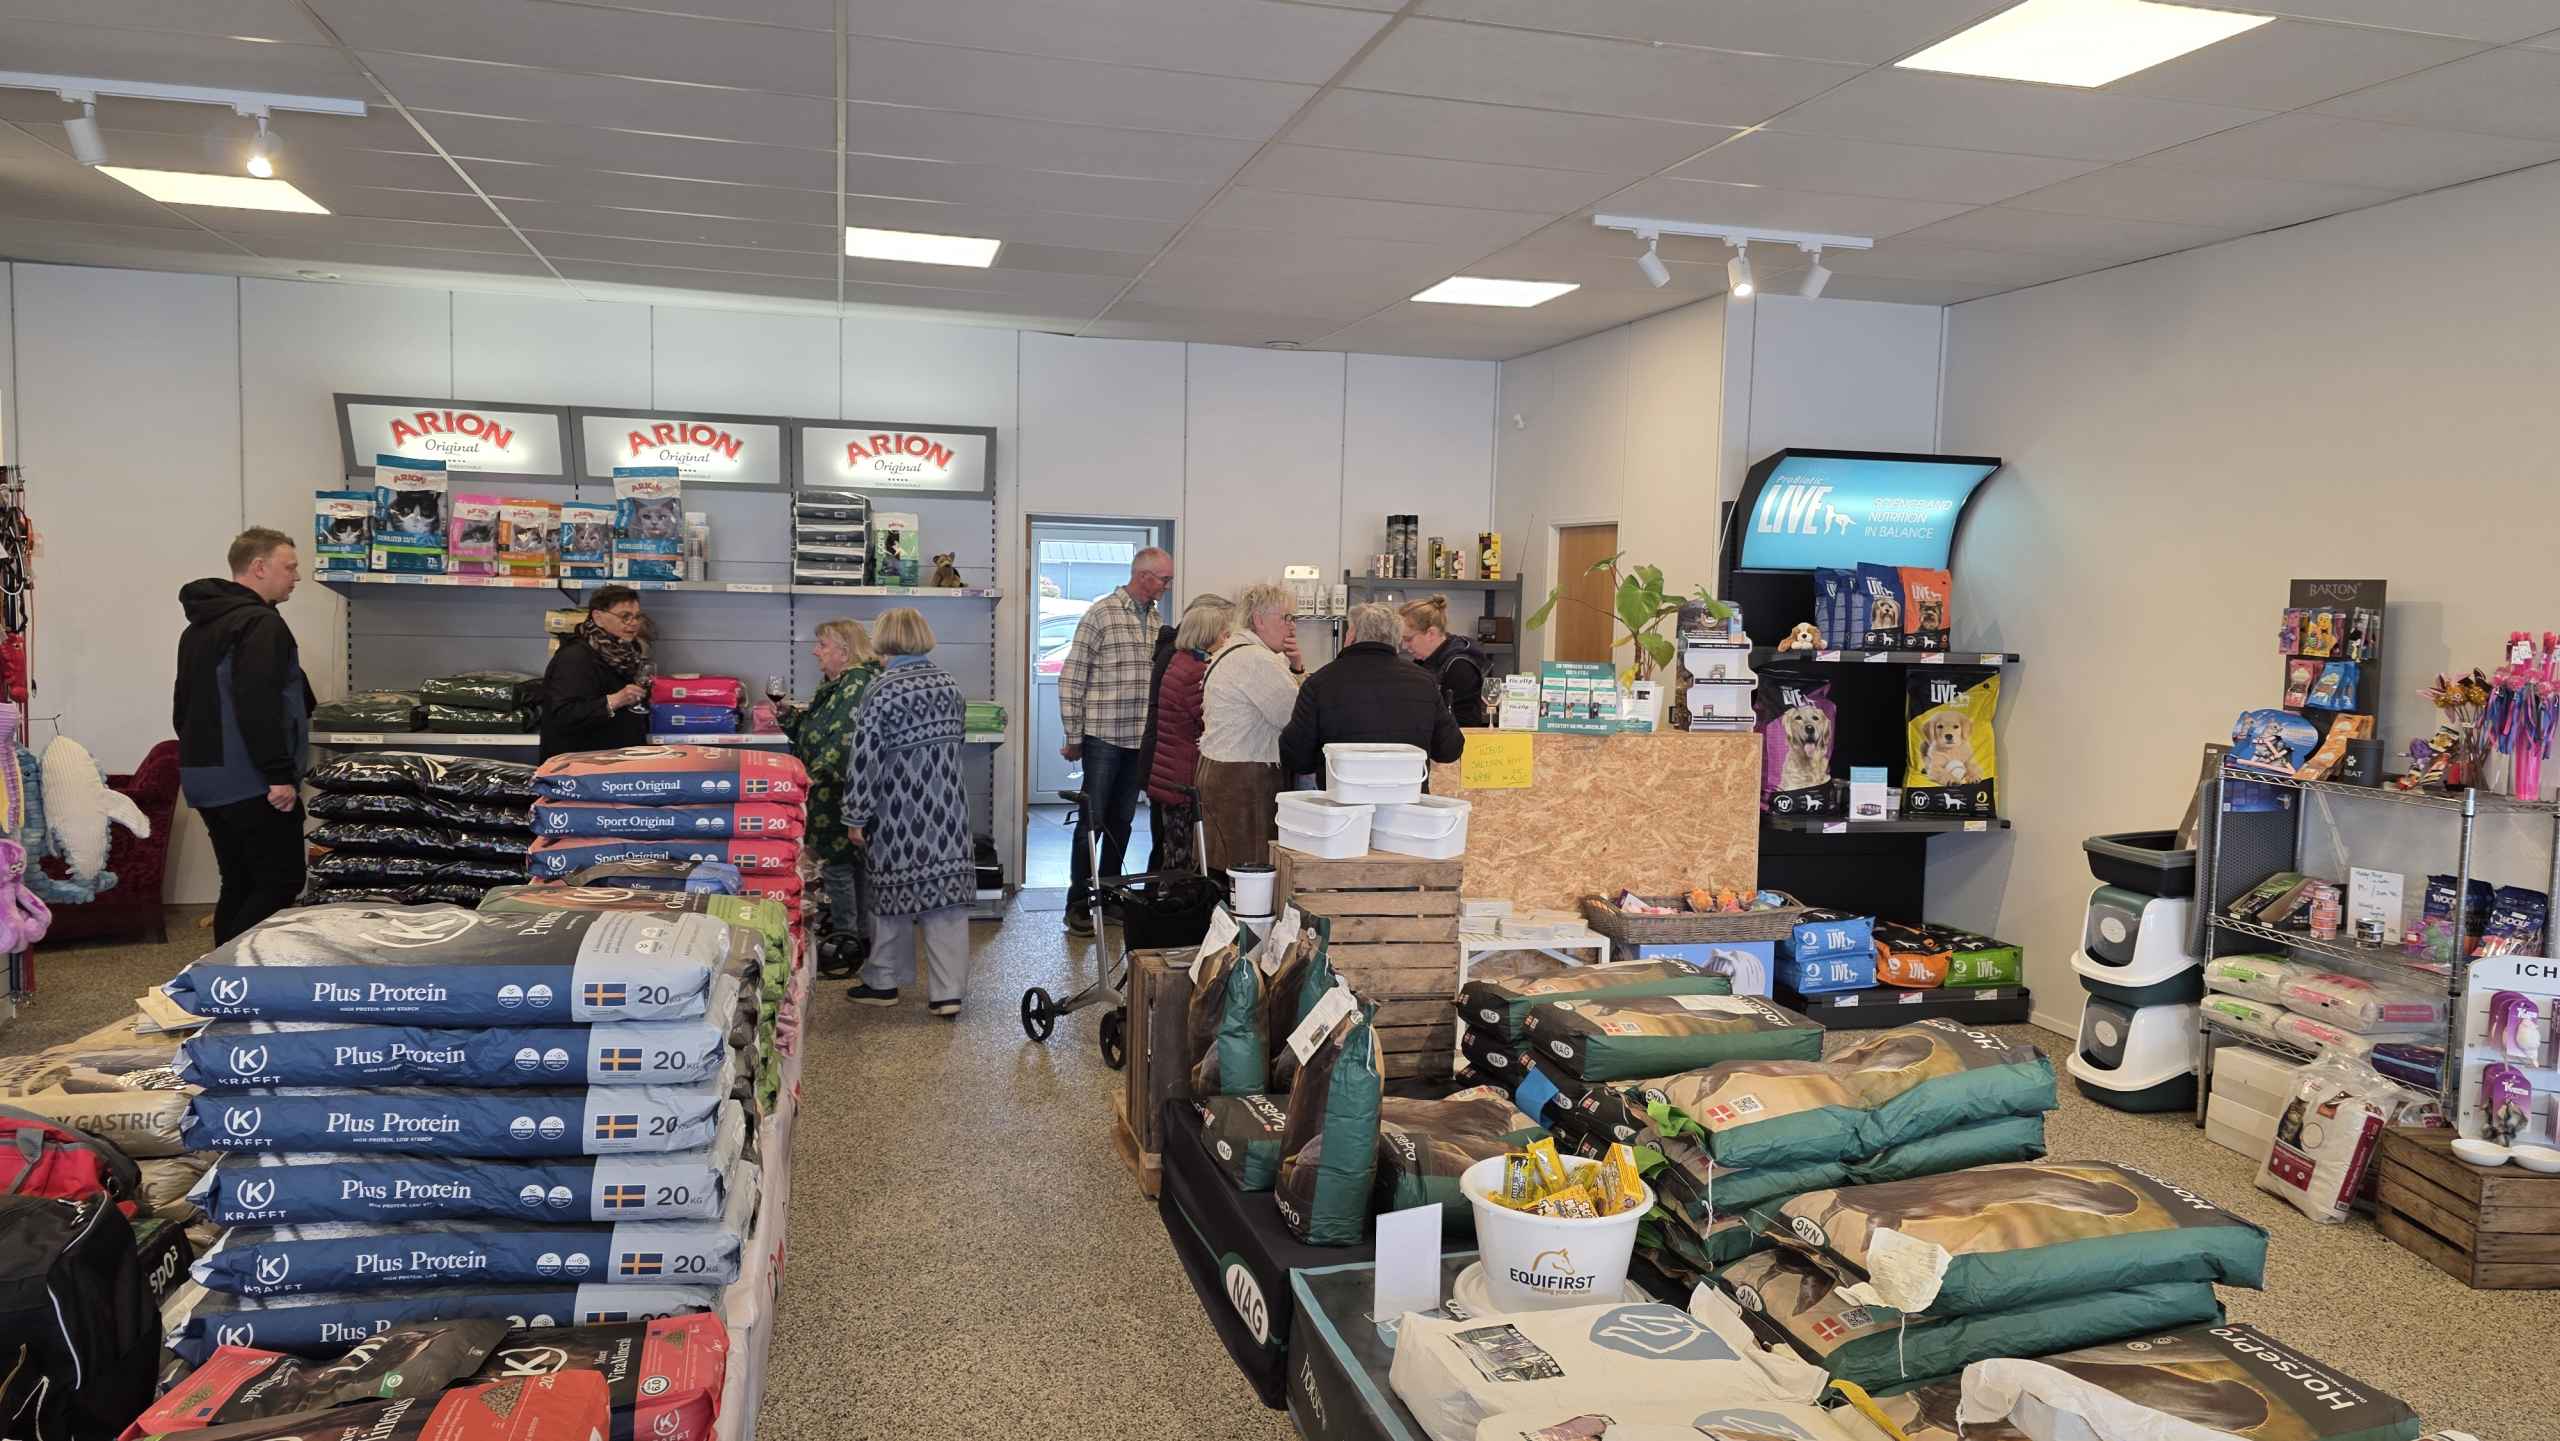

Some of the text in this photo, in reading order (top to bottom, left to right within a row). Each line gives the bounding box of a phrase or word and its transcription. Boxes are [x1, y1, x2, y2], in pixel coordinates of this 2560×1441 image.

[390, 410, 515, 449] ARION
[425, 438, 480, 455] Original
[628, 422, 744, 459] ARION
[659, 449, 710, 465] Original
[846, 432, 955, 470] ARION
[873, 459, 921, 473] Original
[1758, 484, 1834, 534] LIVE
[1864, 527, 1935, 539] IN BALANCE
[2309, 583, 2358, 597] BARTON
[1930, 683, 1957, 704] LIVE
[602, 779, 680, 793] Sport Original
[773, 781, 791, 792] 20
[596, 815, 675, 828] Sport Original
[767, 819, 786, 830] 20
[595, 850, 669, 862] Sport Original
[761, 856, 778, 868] 20
[767, 890, 784, 901] 20
[2432, 893, 2457, 904] WOO
[1827, 930, 1847, 950] LIVE
[1831, 962, 1850, 981] LIVE
[1976, 959, 1994, 978] LIVE
[312, 983, 447, 1002] Plus Protein
[638, 986, 670, 1005] 20
[201, 1007, 260, 1016] KRAFFT
[335, 1043, 465, 1066] Plus Protein
[1554, 1042, 1572, 1056] NAG
[654, 1051, 685, 1070] 20
[218, 1075, 280, 1085] KRAFFT
[75, 1111, 165, 1132] GASTRIC
[326, 1112, 460, 1133] Plus Protein
[649, 1114, 678, 1136] 20
[211, 1138, 272, 1147] KRAFFT
[340, 1180, 471, 1200] Plus Protein
[656, 1186, 689, 1206] 20
[225, 1210, 287, 1221] KRAFFT
[1796, 1220, 1822, 1245] NAG
[355, 1250, 487, 1273] Plus Protein
[673, 1255, 705, 1273] 20
[1510, 1267, 1596, 1290] EQUIFIRST
[244, 1283, 302, 1294] KRAFFT
[1231, 1267, 1265, 1340] NAG
[320, 1323, 366, 1342] Plus
[2209, 1328, 2355, 1410] HorsePro
